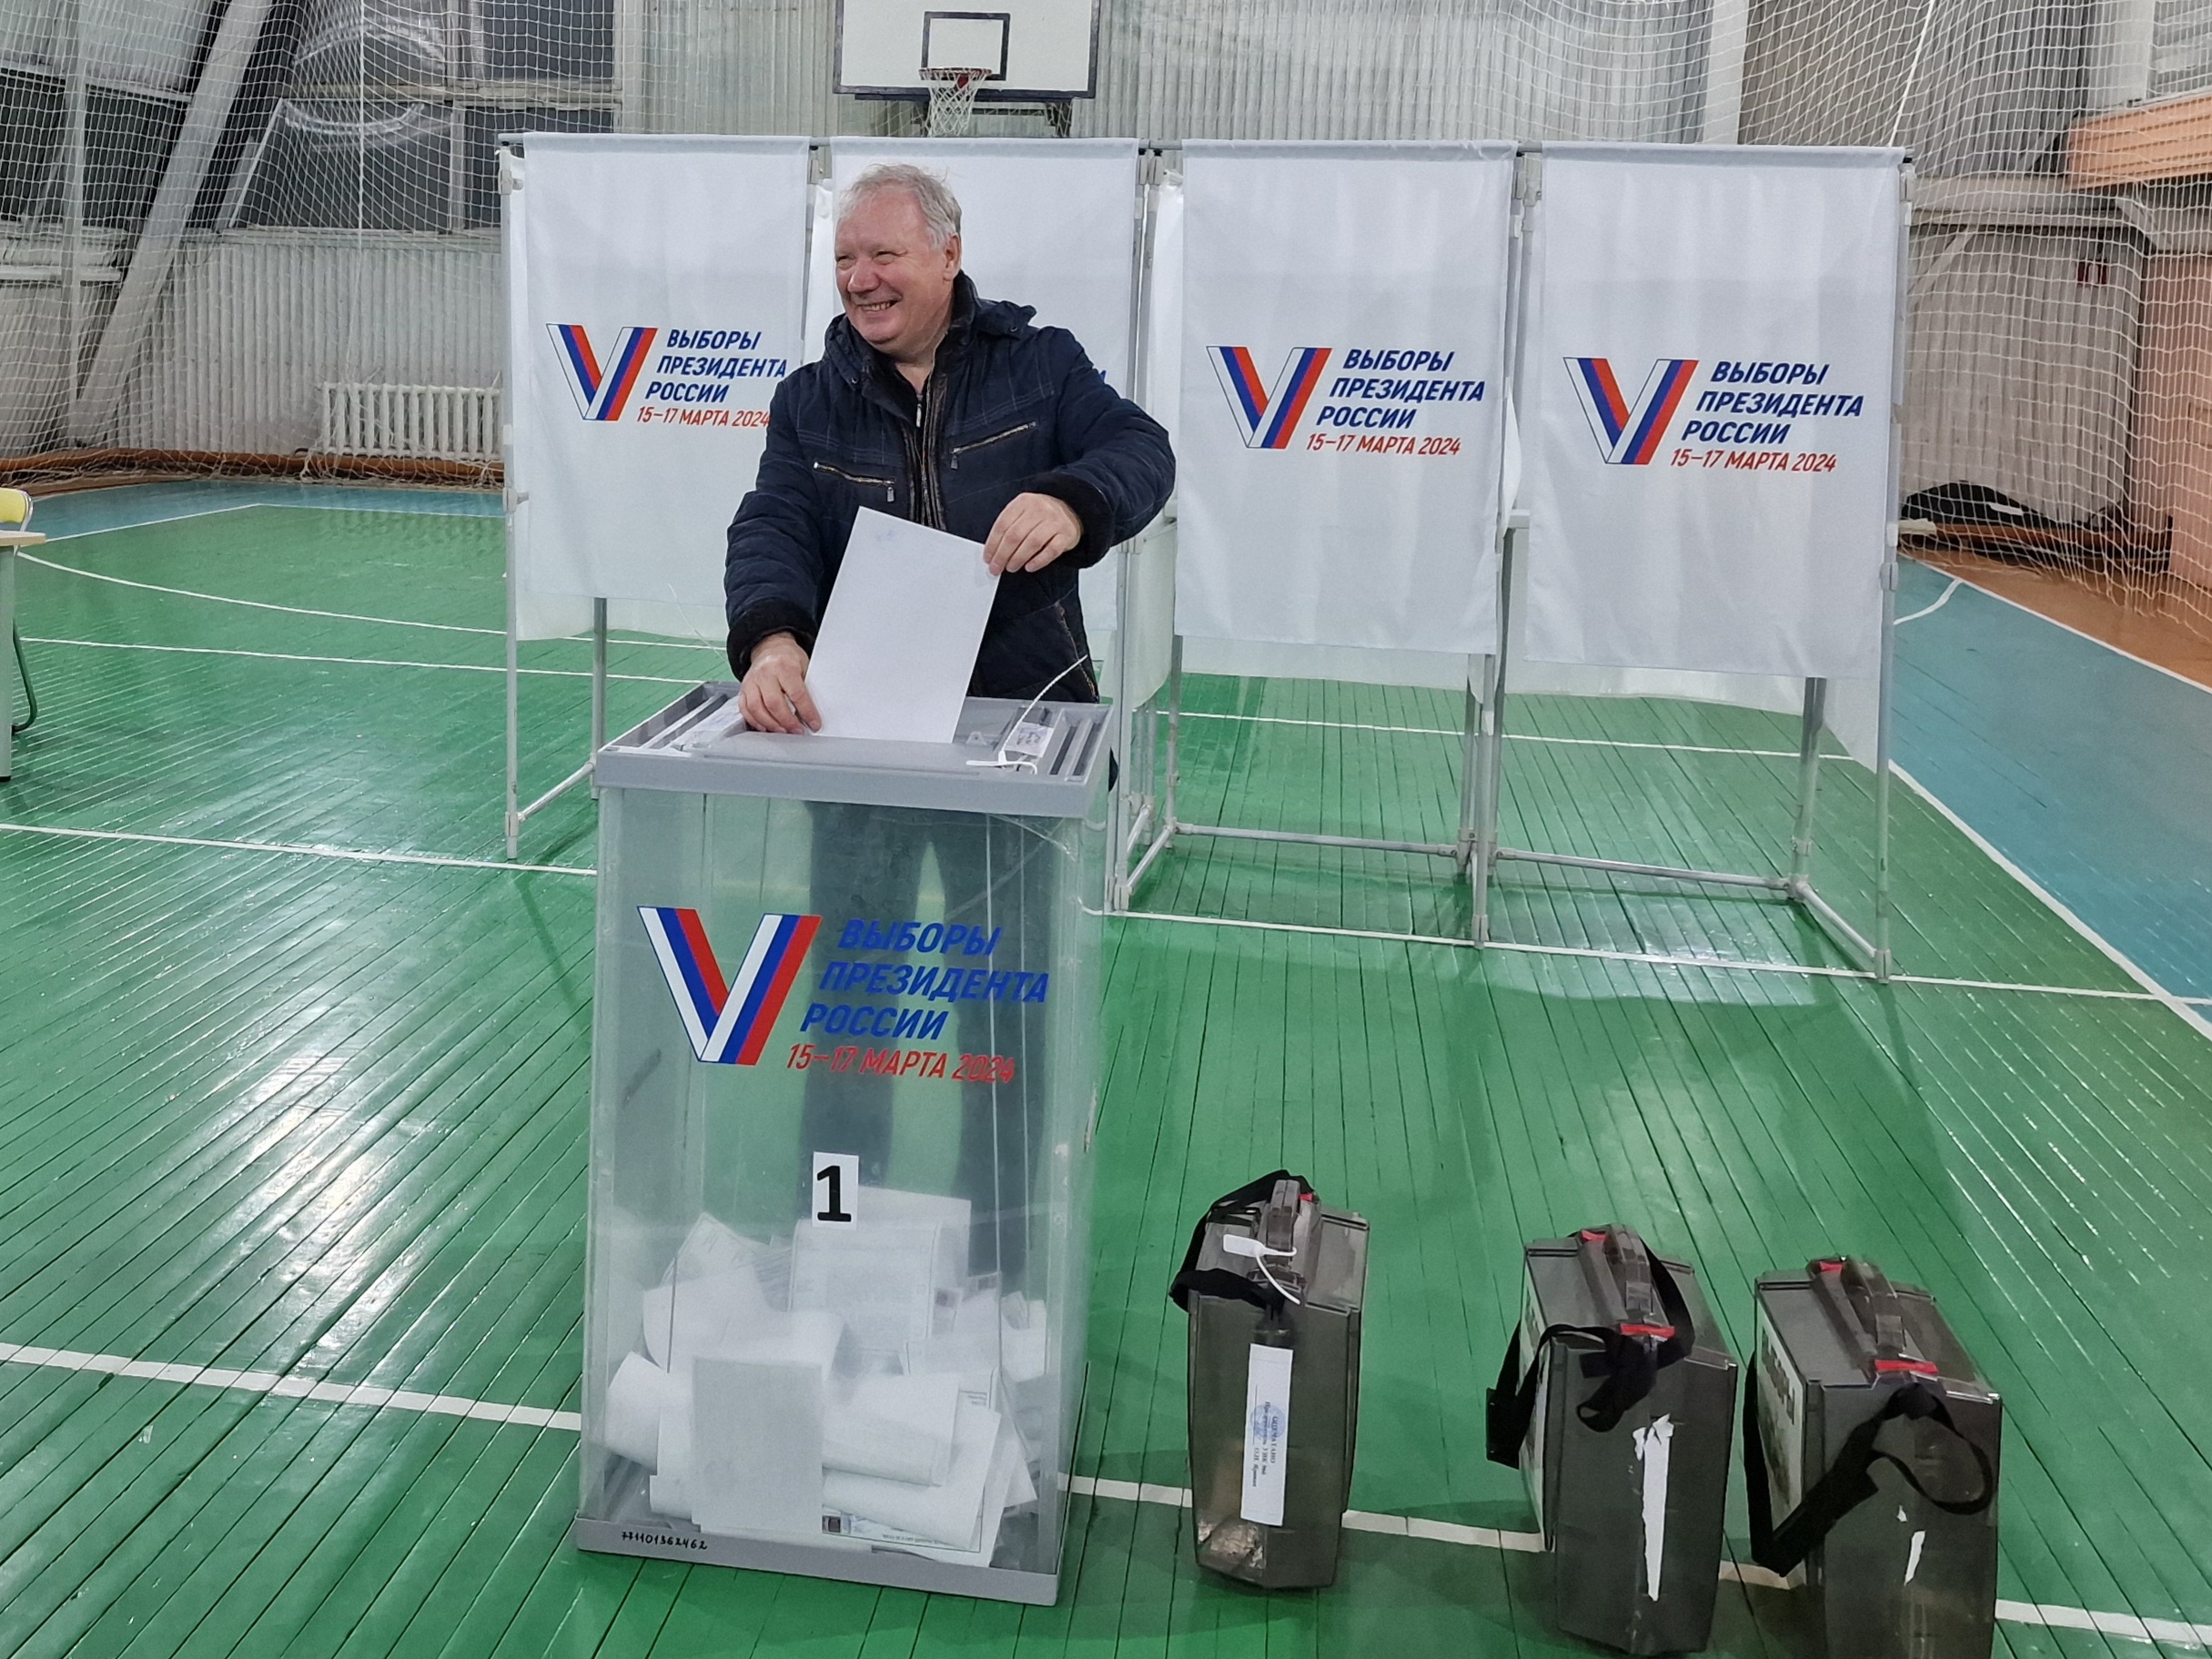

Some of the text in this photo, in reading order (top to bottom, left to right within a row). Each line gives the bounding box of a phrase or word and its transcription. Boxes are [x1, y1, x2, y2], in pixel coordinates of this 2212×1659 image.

[667, 329, 762, 350] ВЫБОРЫ
[656, 356, 787, 379] ПРЕЗИДЕНТА
[1343, 349, 1455, 372] ВЫБОРЫ
[1710, 361, 1830, 385] ВЫБОРЫ
[644, 381, 730, 403] РОССИИ
[1328, 378, 1485, 403] ПРЕЗИДЕНТА
[1695, 391, 1864, 418] ПРЕЗИДЕНТА
[680, 409, 729, 426] МАРТА
[732, 410, 771, 427] 2024
[1316, 406, 1417, 430] РОССИИ
[1682, 420, 1791, 444] РОССИИ
[1356, 435, 1413, 454] МАРТА
[1418, 437, 1461, 455] 2024
[1723, 450, 1790, 471] МАРТА
[1791, 453, 1837, 472] 2024
[837, 918, 1003, 956] ВЫБОРЫ
[818, 961, 1050, 1003] ПРЕЗИДЕНТА
[800, 1003, 949, 1040] РОССИИ
[859, 1048, 949, 1079] МАРТА
[951, 1053, 1015, 1083] 2024
[816, 1165, 852, 1222] 1
